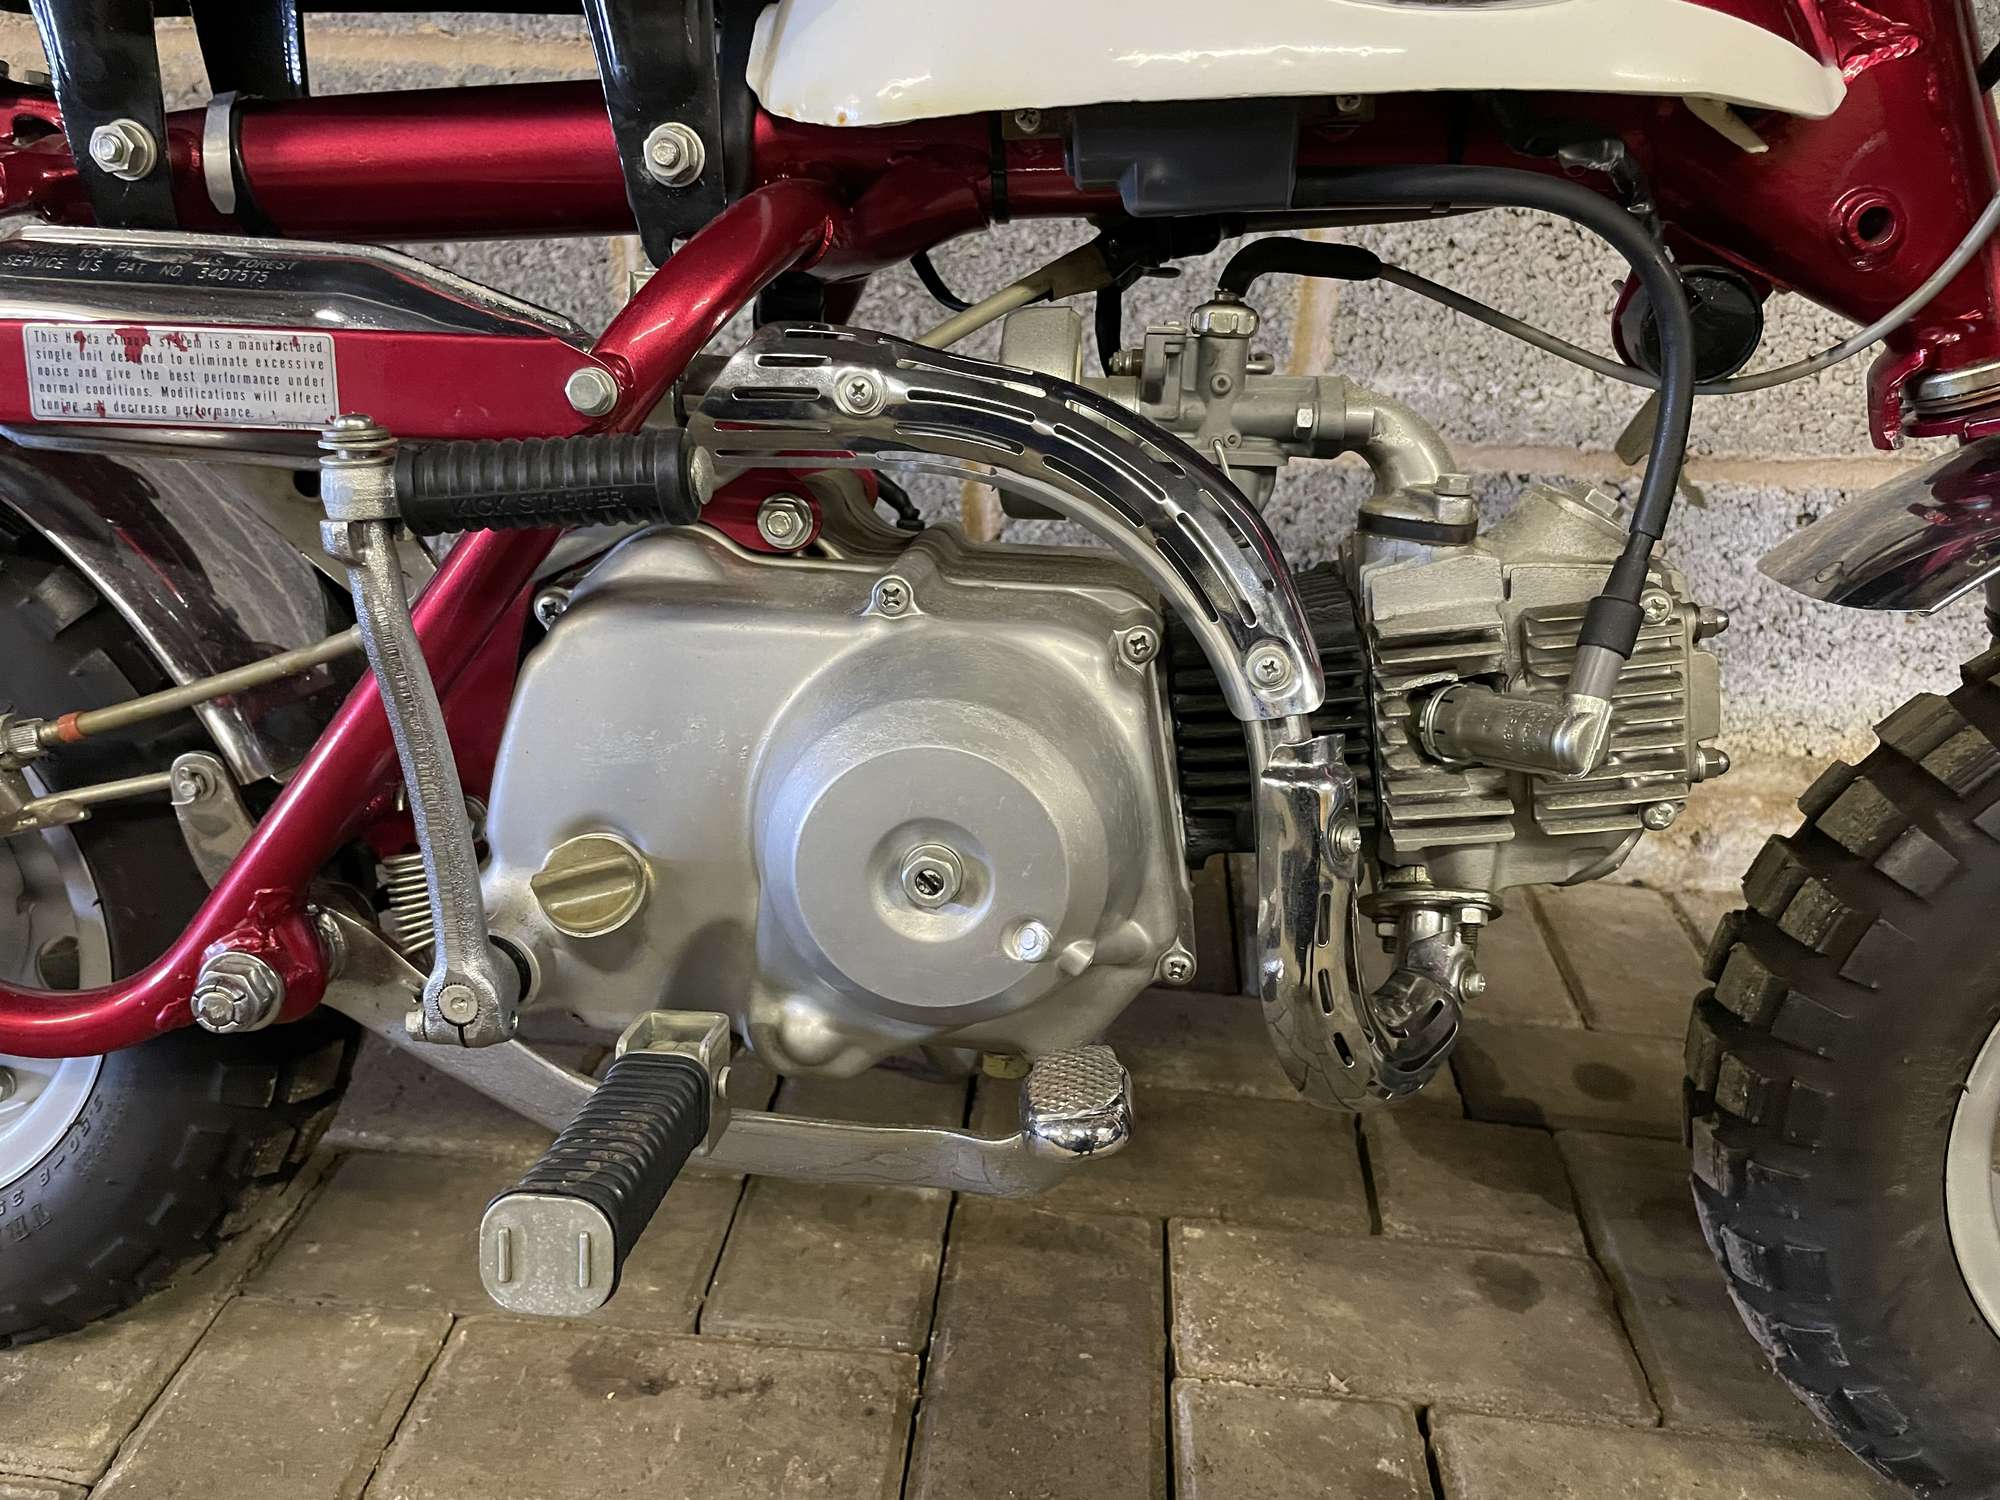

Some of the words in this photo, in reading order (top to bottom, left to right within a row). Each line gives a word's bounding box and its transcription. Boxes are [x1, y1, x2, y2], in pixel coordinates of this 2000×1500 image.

[2, 254, 69, 270] SERVICE
[197, 267, 270, 283] 3407575
[234, 258, 299, 271] FOREST
[34, 330, 58, 344] This
[65, 331, 99, 345] Hoda
[210, 338, 220, 347] is
[227, 339, 233, 347] a
[239, 338, 323, 353] manufactured
[36, 349, 72, 363] single
[80, 350, 103, 362] unit
[111, 351, 163, 364] desned
[171, 354, 183, 365] to
[190, 353, 248, 367] eliminate
[256, 357, 324, 370] excessive
[38, 366, 69, 377] noise
[78, 367, 97, 378] and
[106, 367, 131, 381] give
[141, 368, 159, 381] the
[170, 369, 195, 382] best
[204, 371, 280, 386] performance
[288, 376, 325, 387] under
[40, 382, 79, 394] normal
[86, 384, 152, 397] conditions.
[161, 386, 246, 401] Modifications
[254, 390, 278, 403] will
[285, 391, 327, 405] affect
[42, 399, 78, 413] tuning
[114, 401, 167, 414] decrease
